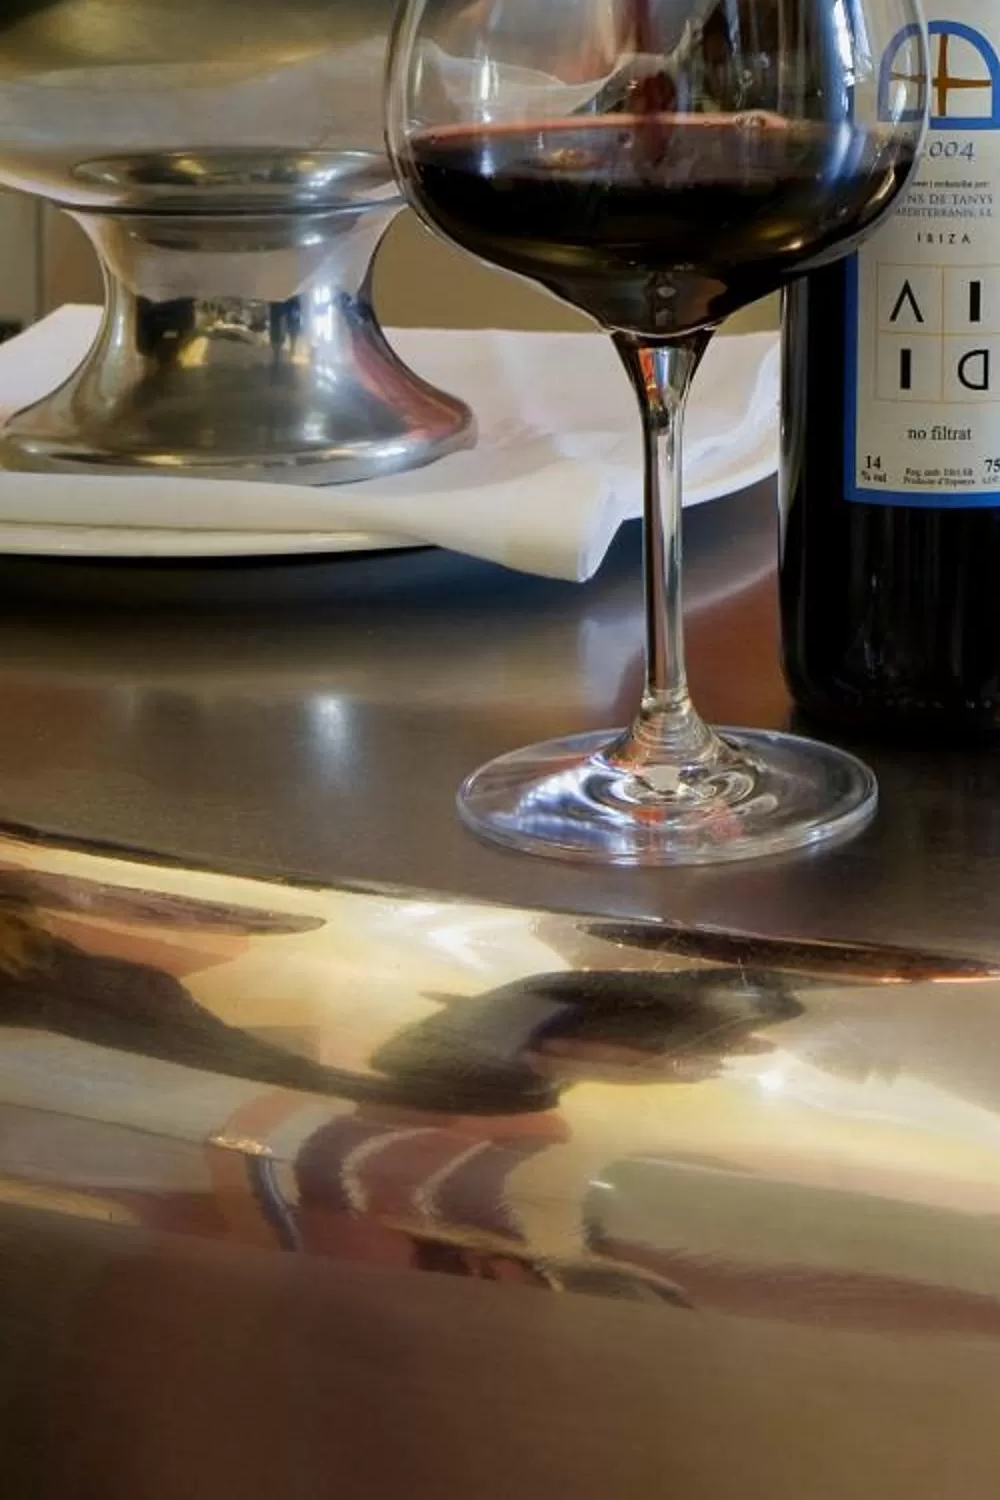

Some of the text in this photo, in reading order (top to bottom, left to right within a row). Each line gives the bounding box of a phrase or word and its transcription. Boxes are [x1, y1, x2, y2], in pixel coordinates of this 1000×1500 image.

[920, 140, 975, 161] 004
[916, 232, 972, 245] IBIZA
[907, 425, 972, 441] no filtrat
[865, 455, 881, 470] 14
